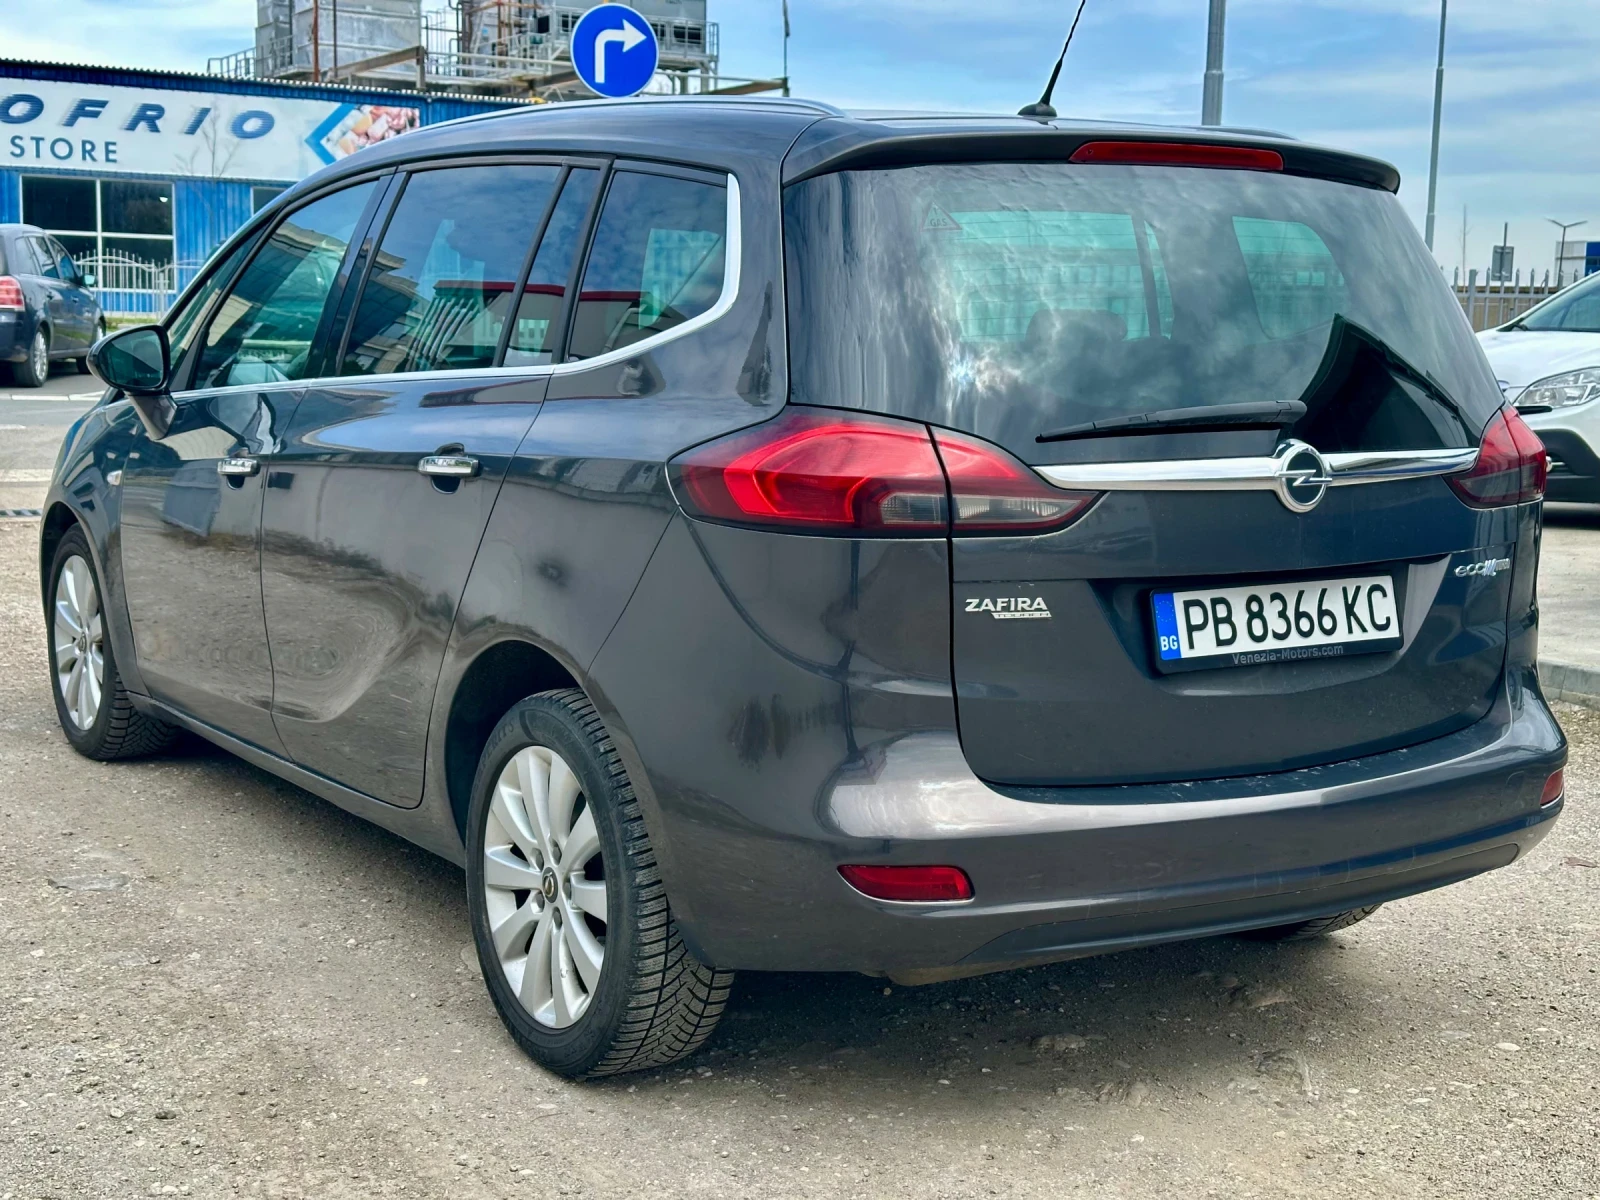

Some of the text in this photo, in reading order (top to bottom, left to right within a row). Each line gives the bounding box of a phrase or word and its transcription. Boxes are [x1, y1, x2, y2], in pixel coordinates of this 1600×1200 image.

[10, 135, 118, 163] STORE
[929, 218, 948, 227] GAS
[965, 597, 1048, 612] ZAFIRA
[1182, 583, 1391, 650] PB 8366 KC
[1160, 636, 1178, 650] BG
[1232, 645, 1344, 665] Venezia-Motors.com
